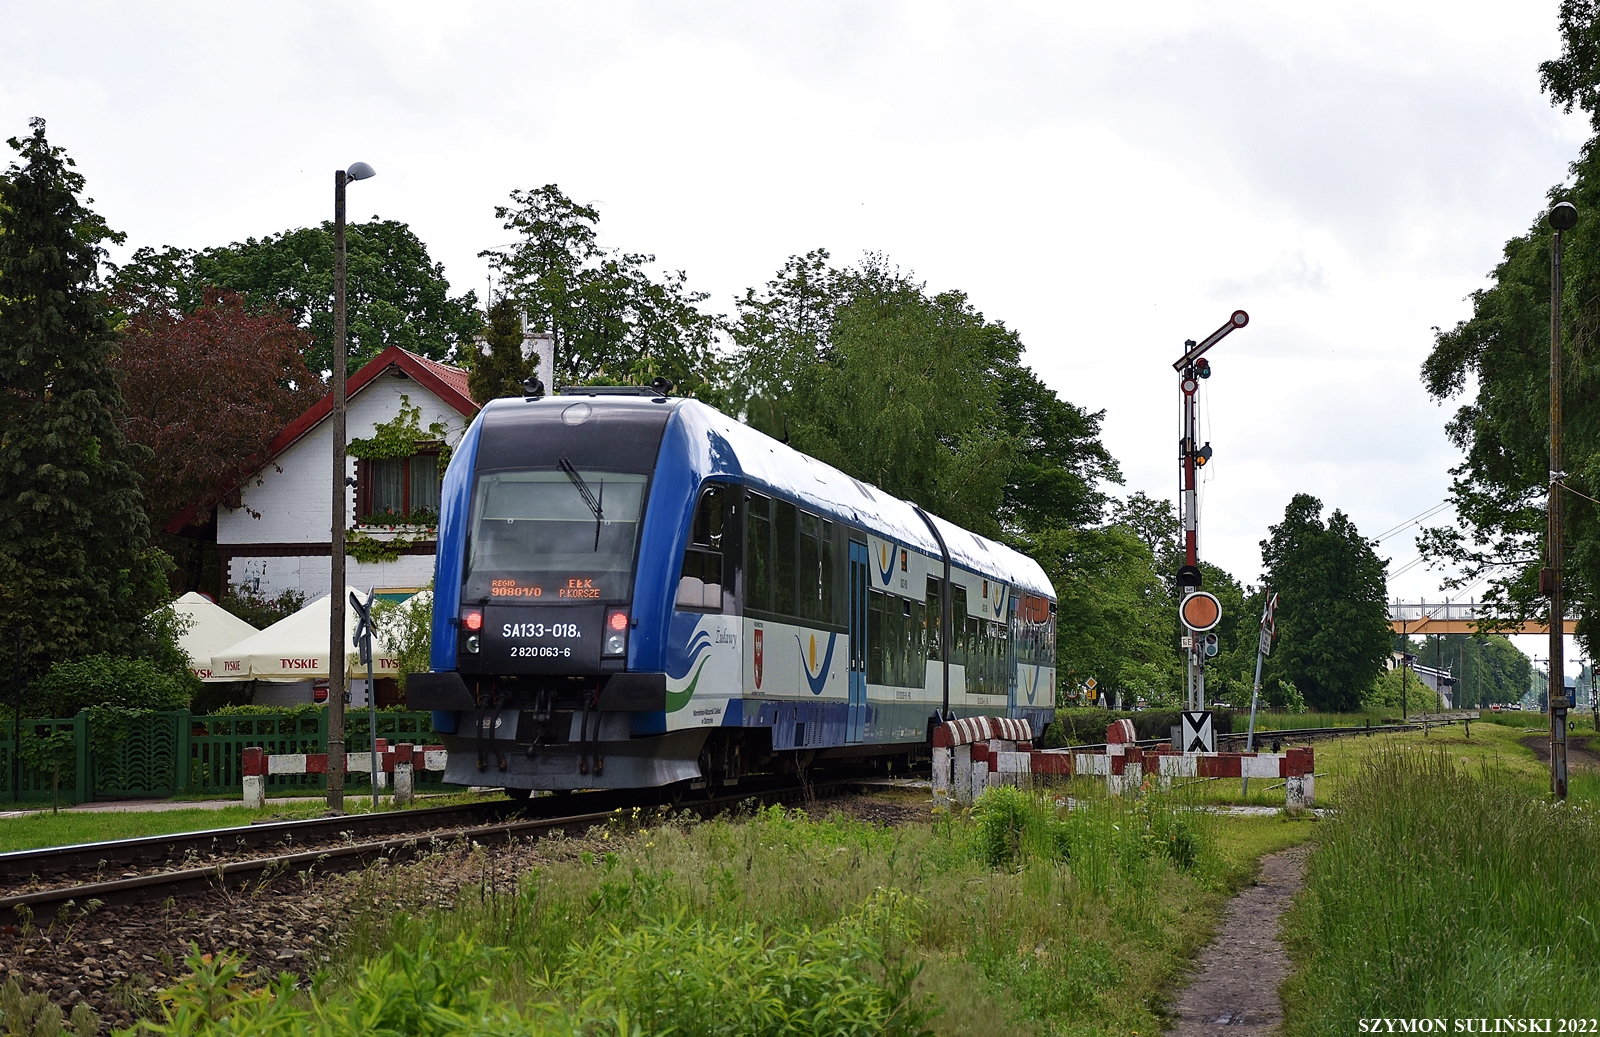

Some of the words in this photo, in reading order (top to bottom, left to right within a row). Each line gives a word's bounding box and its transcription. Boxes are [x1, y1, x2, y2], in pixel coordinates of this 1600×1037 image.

[569, 579, 592, 588] EŁK
[491, 587, 542, 597] 90801/0
[559, 589, 600, 598] P.KORSZE
[510, 647, 517, 657] 2
[518, 647, 538, 657] 820
[539, 647, 571, 657] 063-6
[224, 660, 240, 671] TYSKIE
[280, 658, 318, 669] TYSKIE
[378, 658, 402, 669] TYS
[188, 668, 217, 678] YSK
